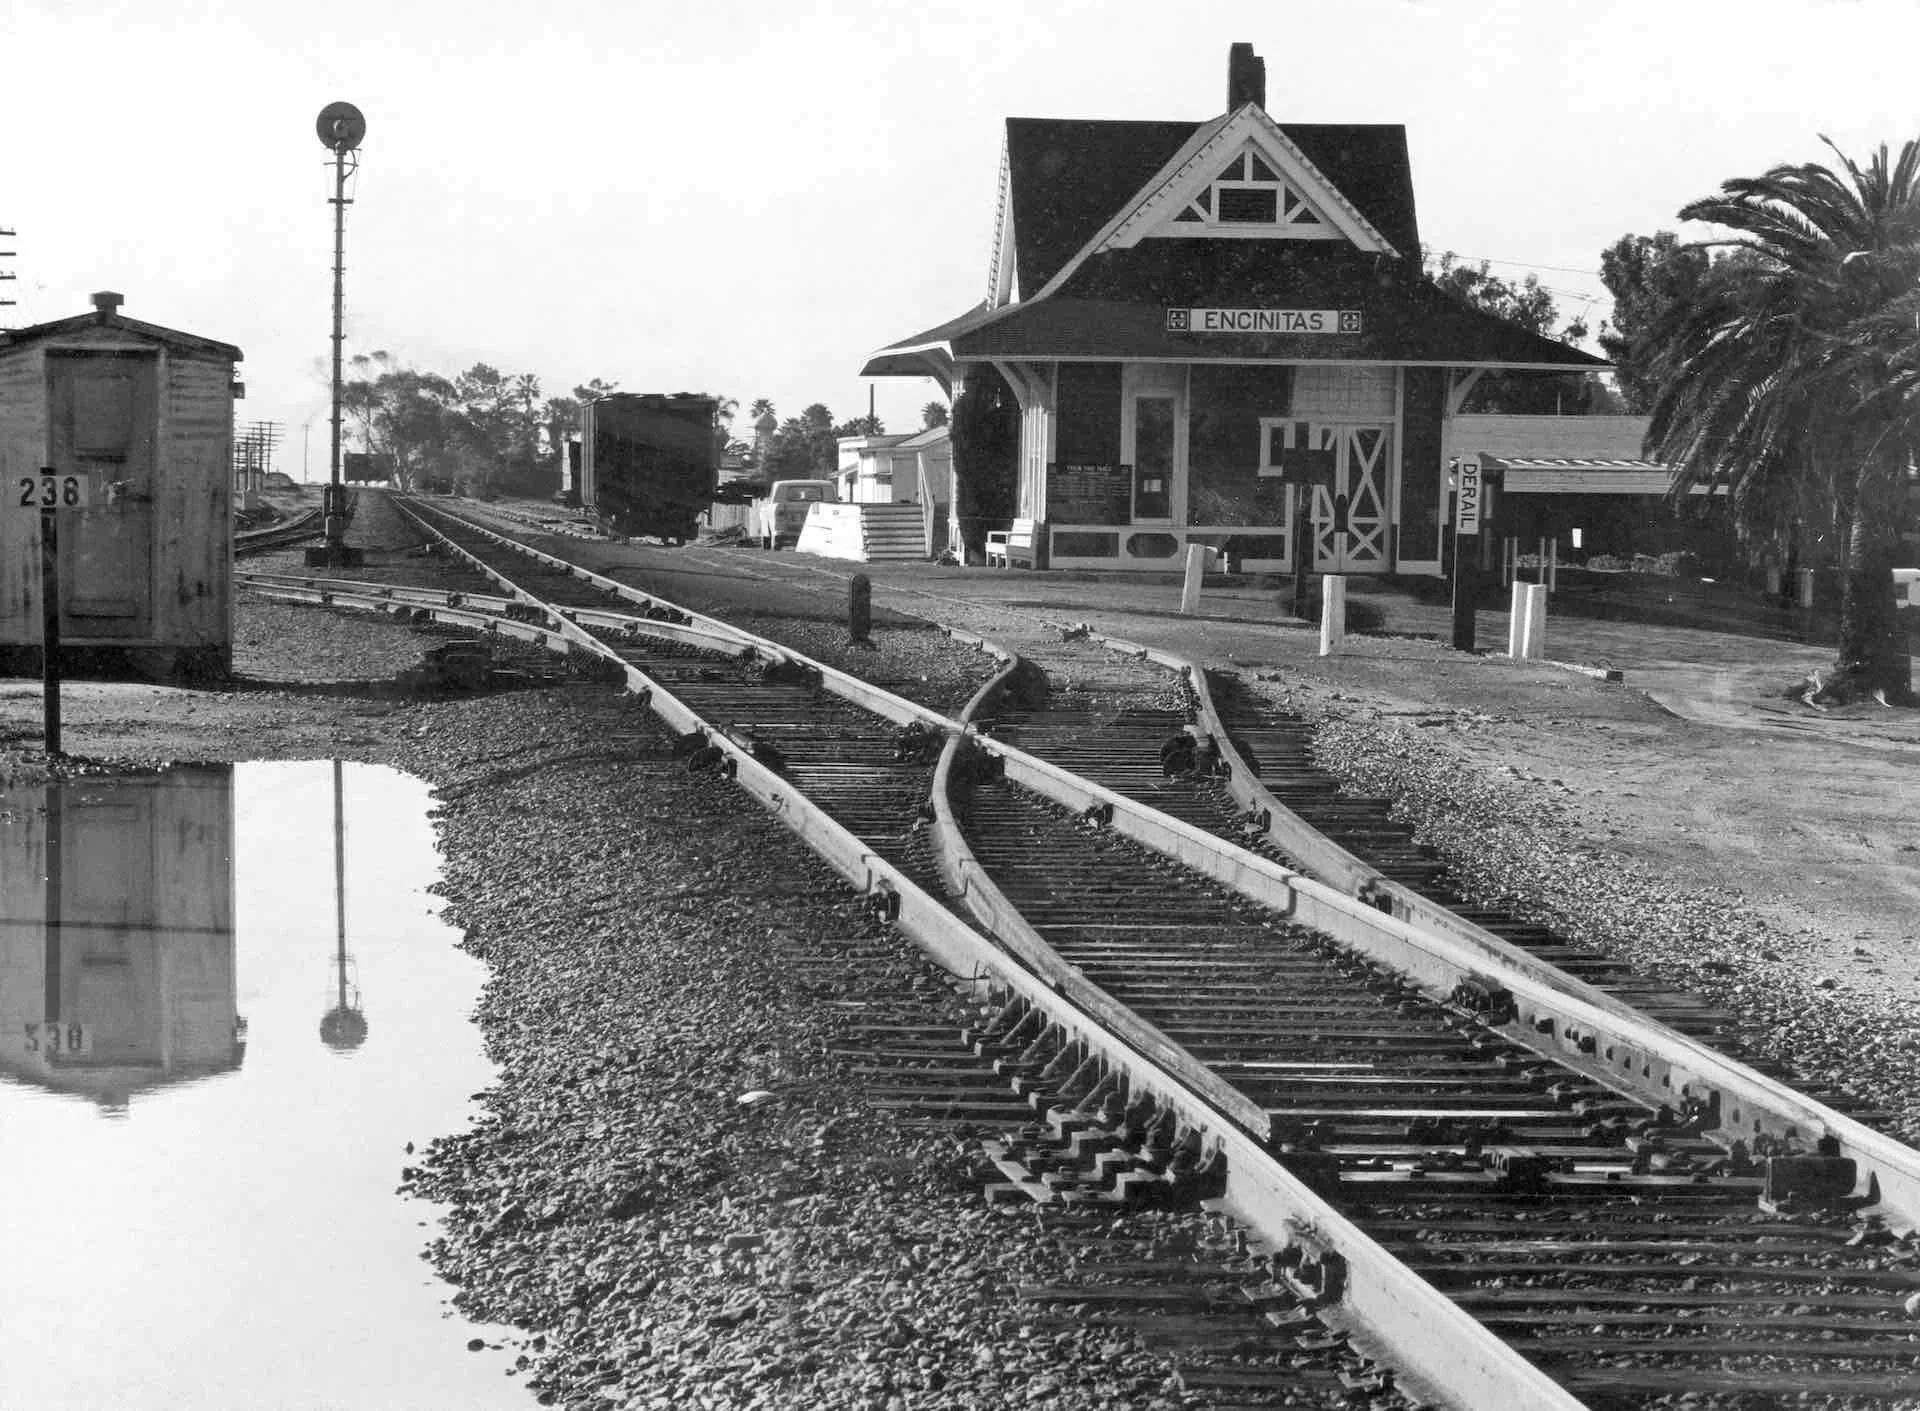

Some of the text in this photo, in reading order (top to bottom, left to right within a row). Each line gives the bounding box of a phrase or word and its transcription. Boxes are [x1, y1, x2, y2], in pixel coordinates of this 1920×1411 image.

[1205, 311, 1323, 331] ENCINITAS
[20, 476, 79, 506] 238
[1461, 464, 1477, 528] DERAIL
